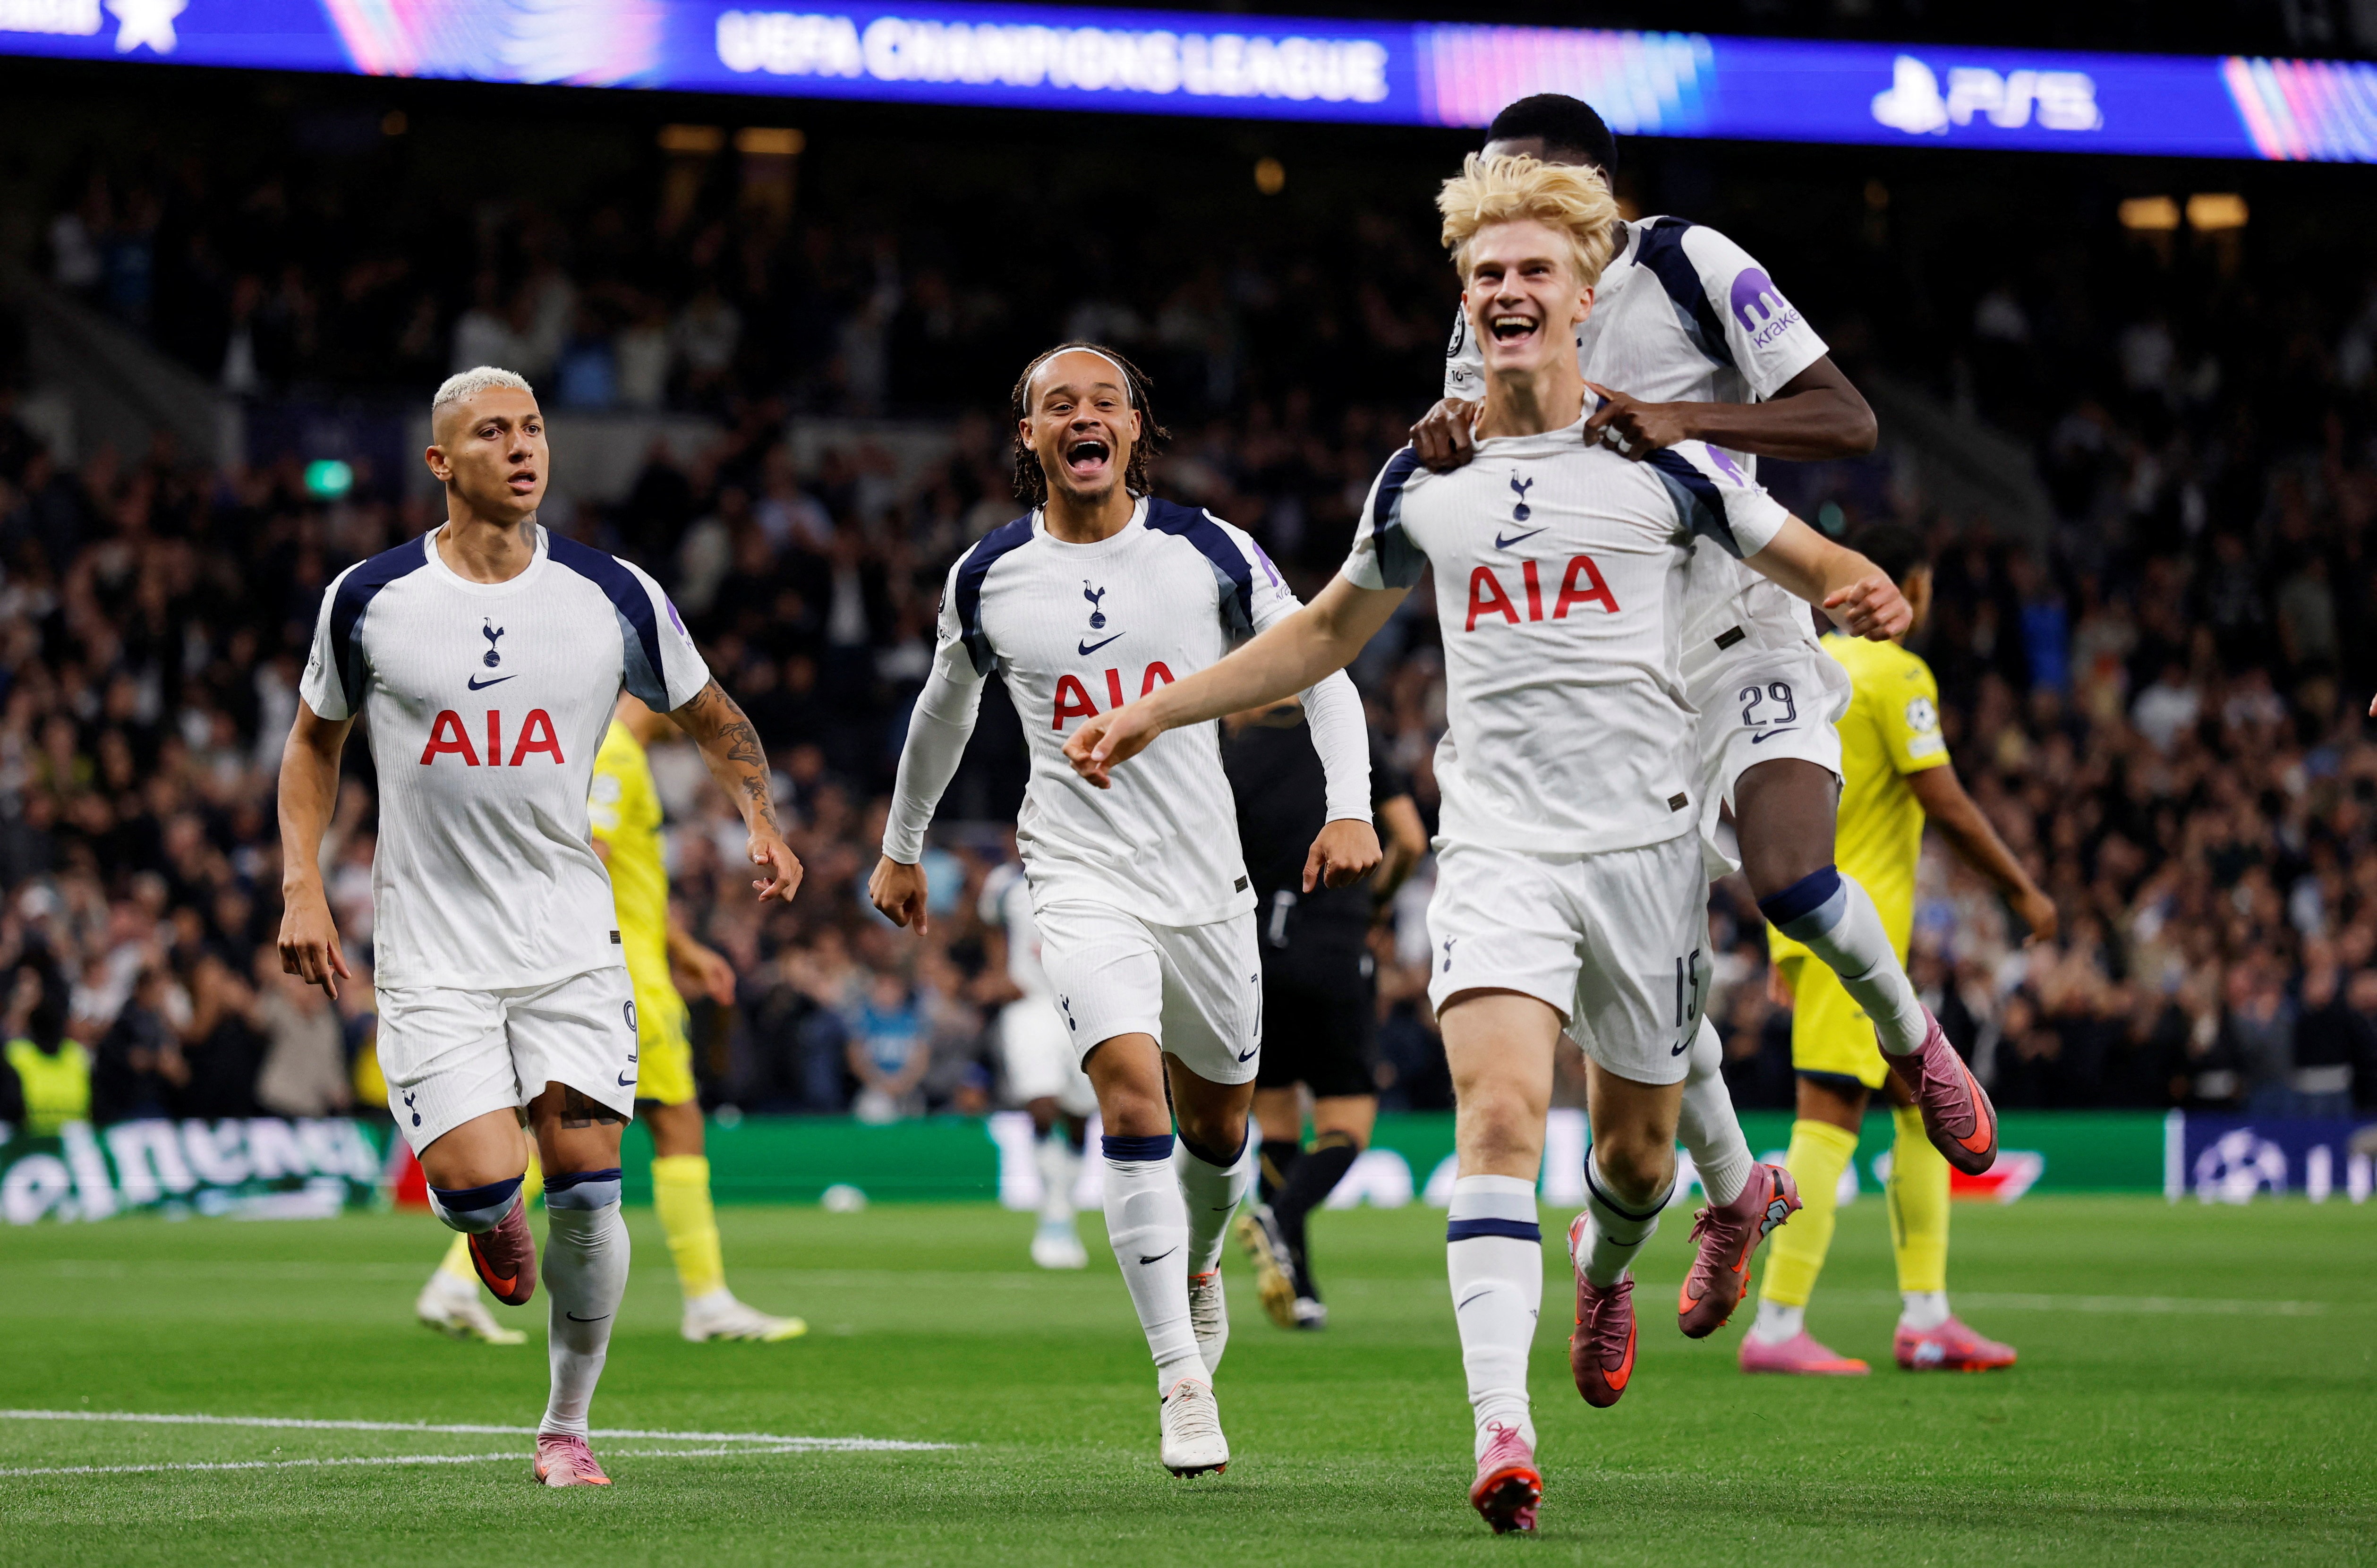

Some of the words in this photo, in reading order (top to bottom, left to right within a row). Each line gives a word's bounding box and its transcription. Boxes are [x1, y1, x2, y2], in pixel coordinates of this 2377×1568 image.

[716, 10, 862, 78] UEFA
[862, 16, 1181, 94] CHAMPIONS
[1183, 32, 1389, 103] LEAGUE
[1946, 67, 2104, 131] PS5
[1753, 308, 1800, 349] krake
[1465, 555, 1620, 632] AIA
[1739, 682, 1797, 726] 29
[420, 708, 565, 767] AIA
[1676, 948, 1700, 1028] 15
[623, 1000, 639, 1064] 9
